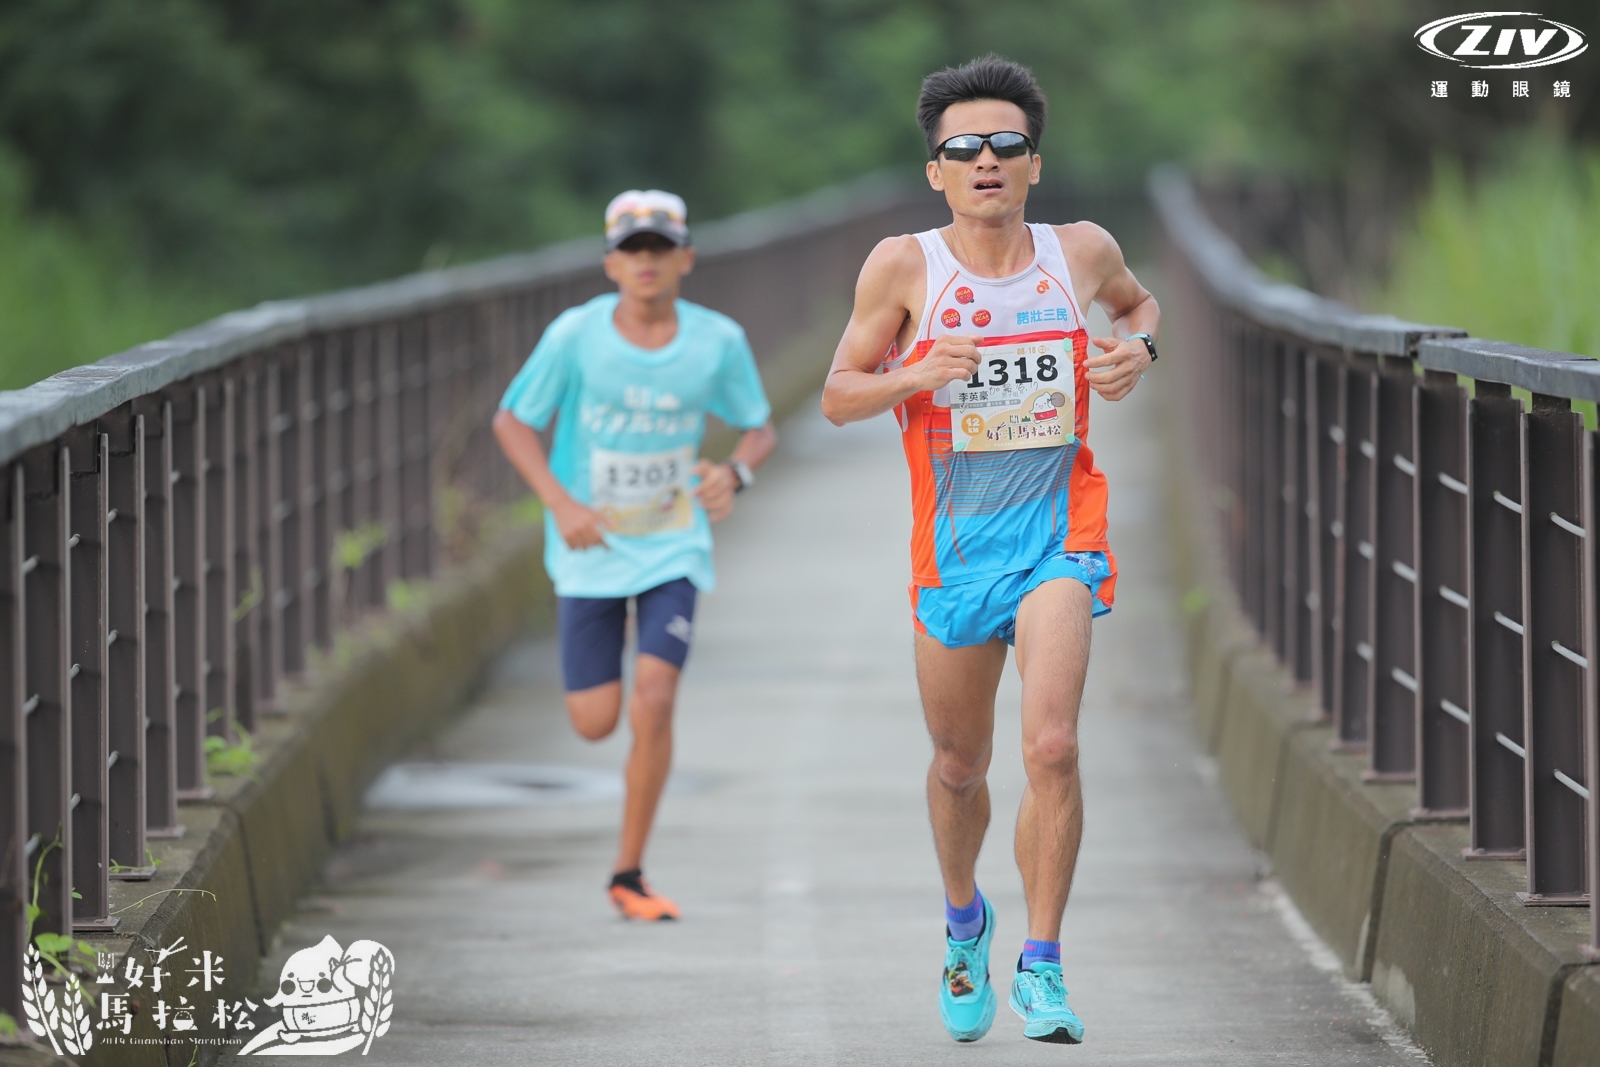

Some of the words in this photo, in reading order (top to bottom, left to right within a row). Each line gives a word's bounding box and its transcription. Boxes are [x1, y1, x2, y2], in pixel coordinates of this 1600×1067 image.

[967, 354, 1058, 389] 1318
[959, 390, 988, 402] 李英豪
[966, 417, 980, 427] 12
